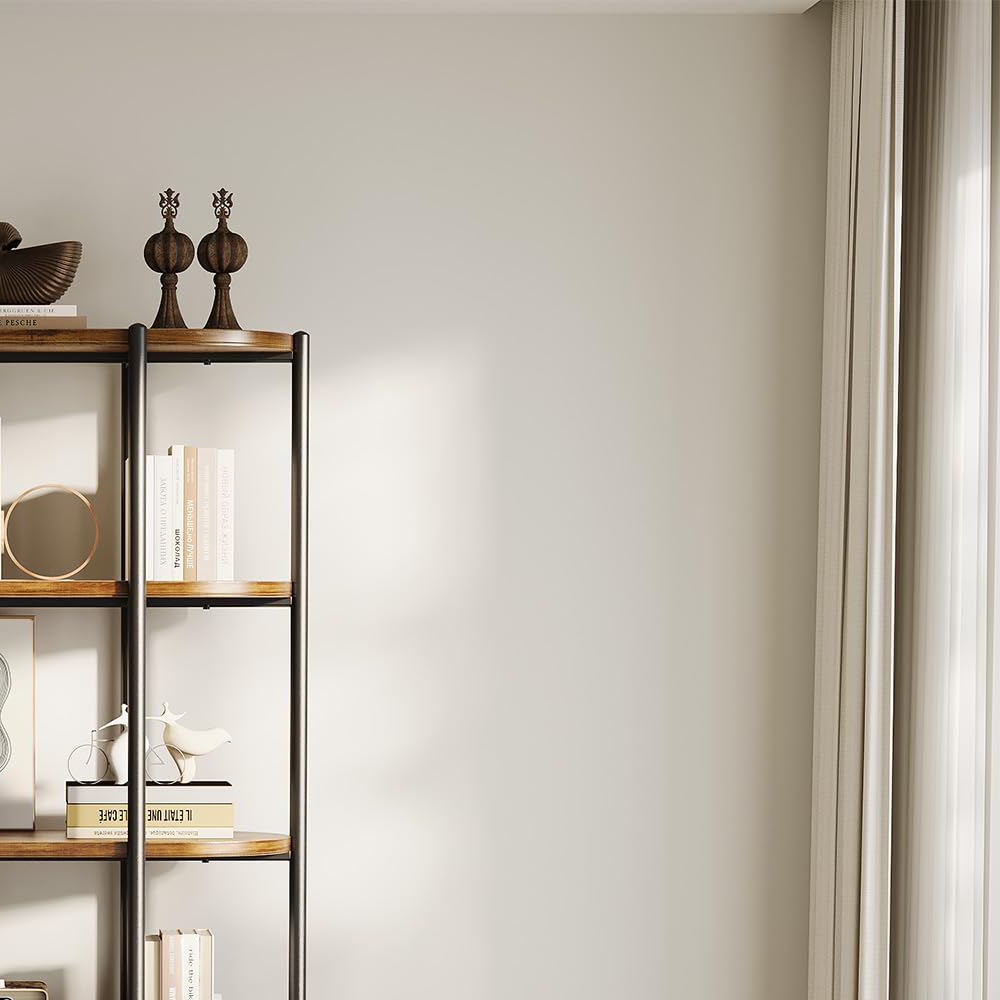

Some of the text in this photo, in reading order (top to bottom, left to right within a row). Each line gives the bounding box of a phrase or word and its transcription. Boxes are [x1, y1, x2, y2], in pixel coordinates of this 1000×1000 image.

[186, 544, 194, 569] ЛУЧШЕ
[99, 809, 192, 824] IL ÉTAIT UNE LE CAFÉ
[168, 987, 176, 1000] WHY
